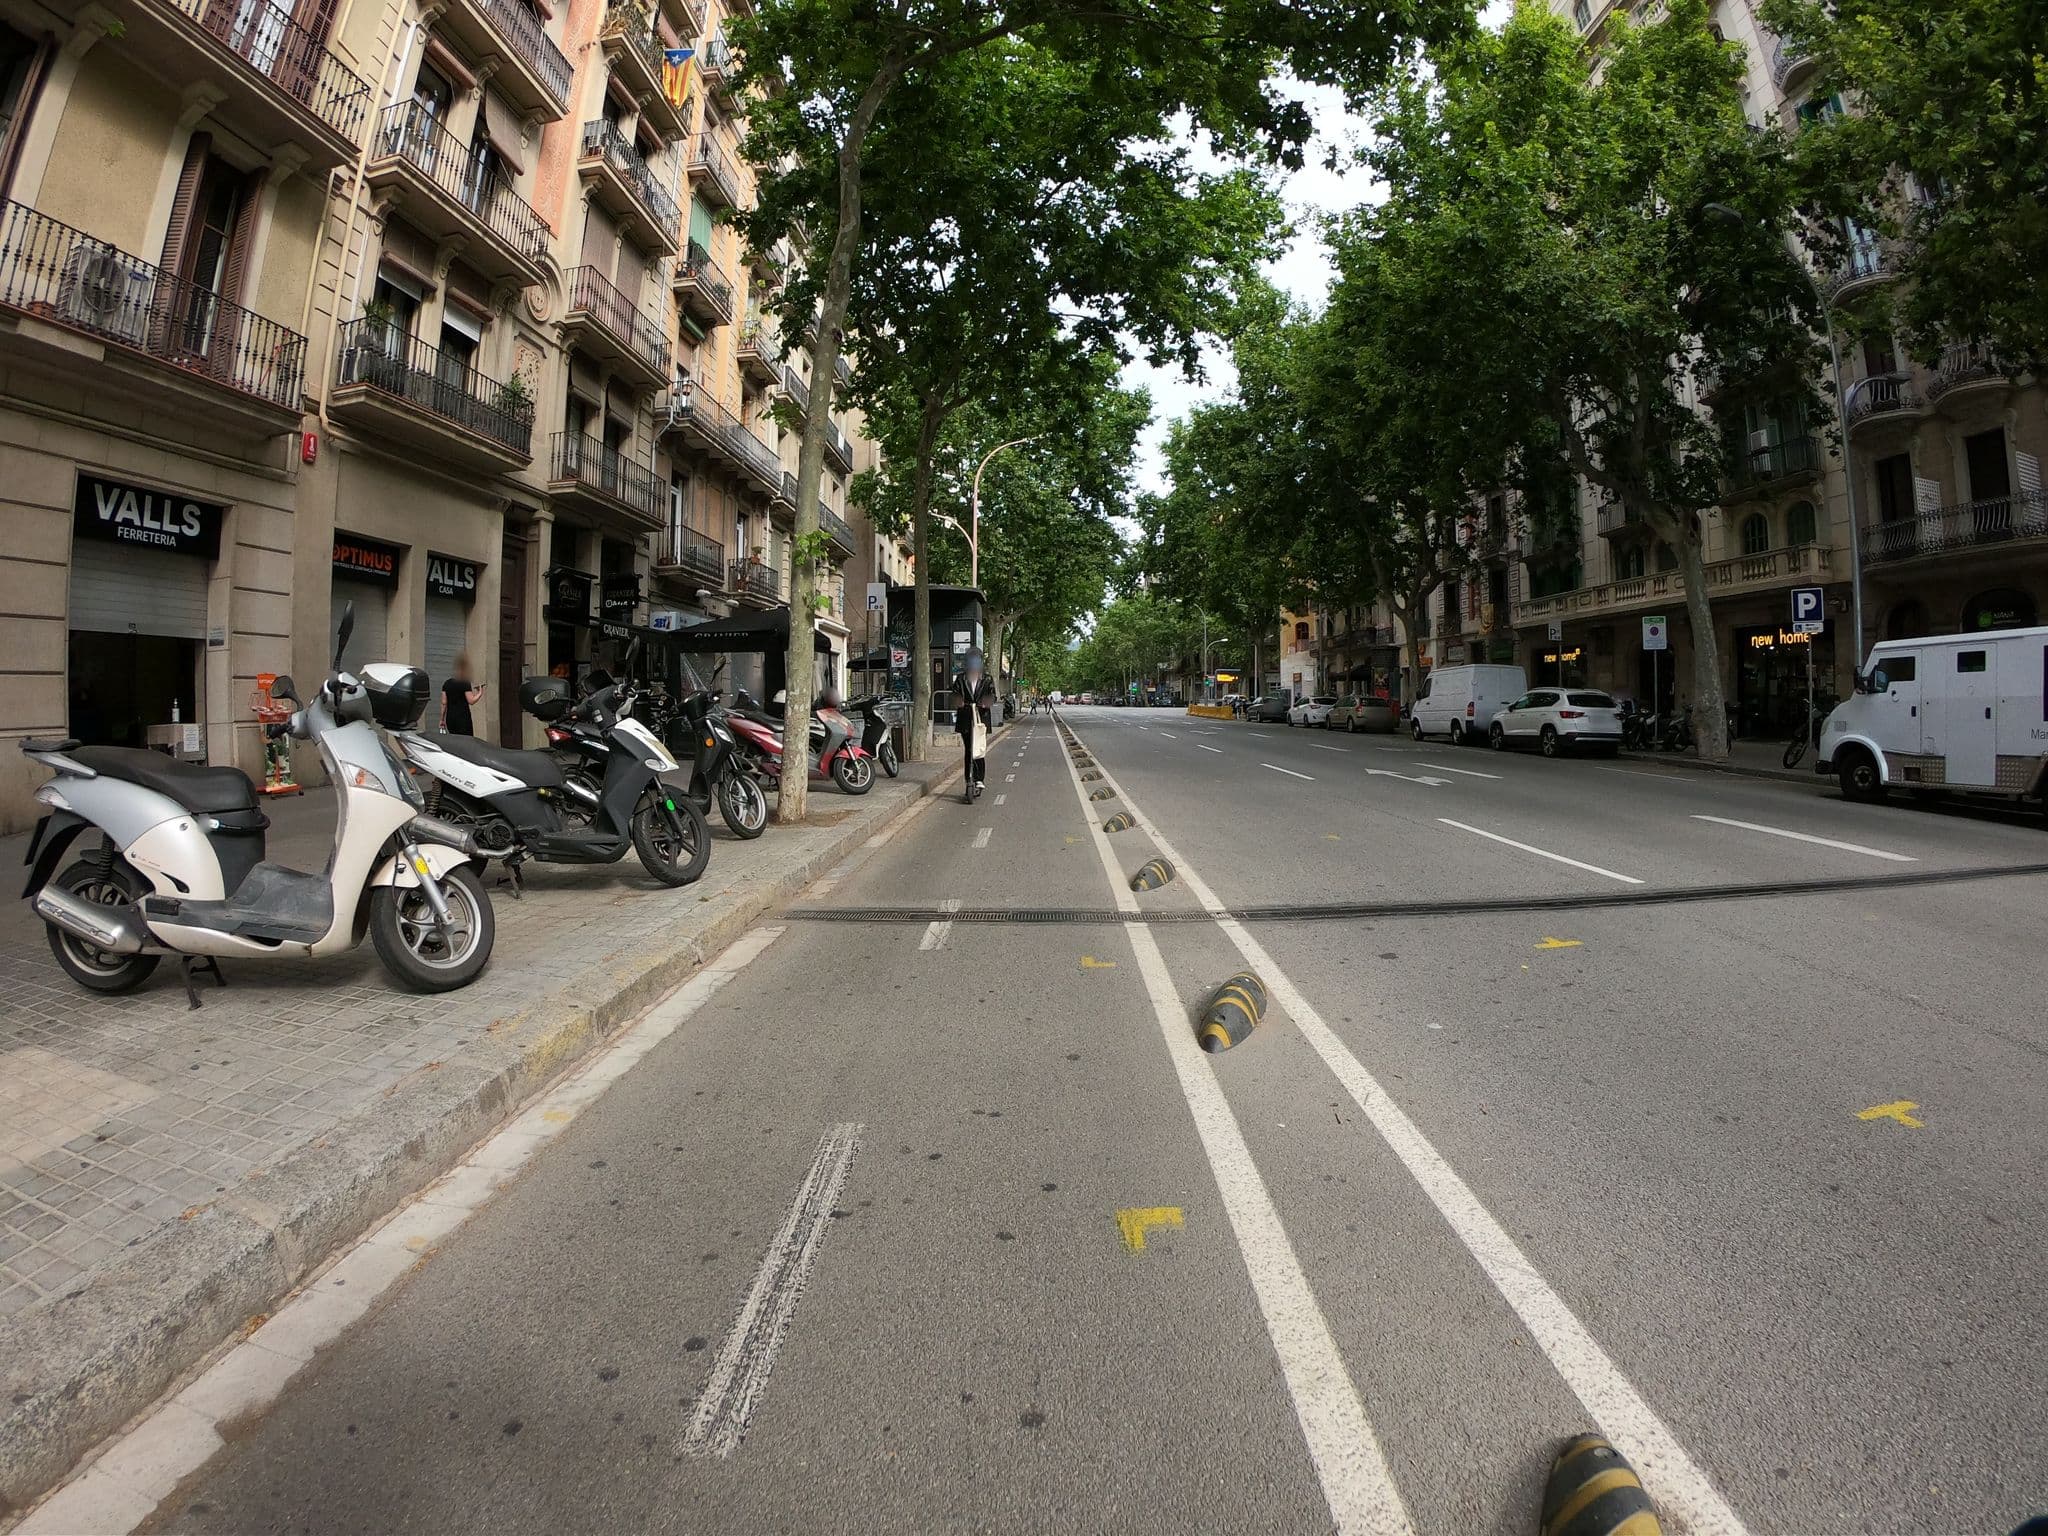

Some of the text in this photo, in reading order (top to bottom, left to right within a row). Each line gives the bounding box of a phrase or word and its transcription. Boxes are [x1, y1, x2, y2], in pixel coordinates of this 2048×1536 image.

[94, 483, 201, 537] VALLS
[117, 526, 177, 547] FERRETERIA
[333, 543, 393, 571] OPTIMUS
[438, 585, 454, 596] CASA
[868, 595, 878, 610] P
[1797, 592, 1817, 619] P
[1751, 634, 1773, 647] new
[1779, 627, 1809, 644] home
[1543, 654, 1557, 663] new
